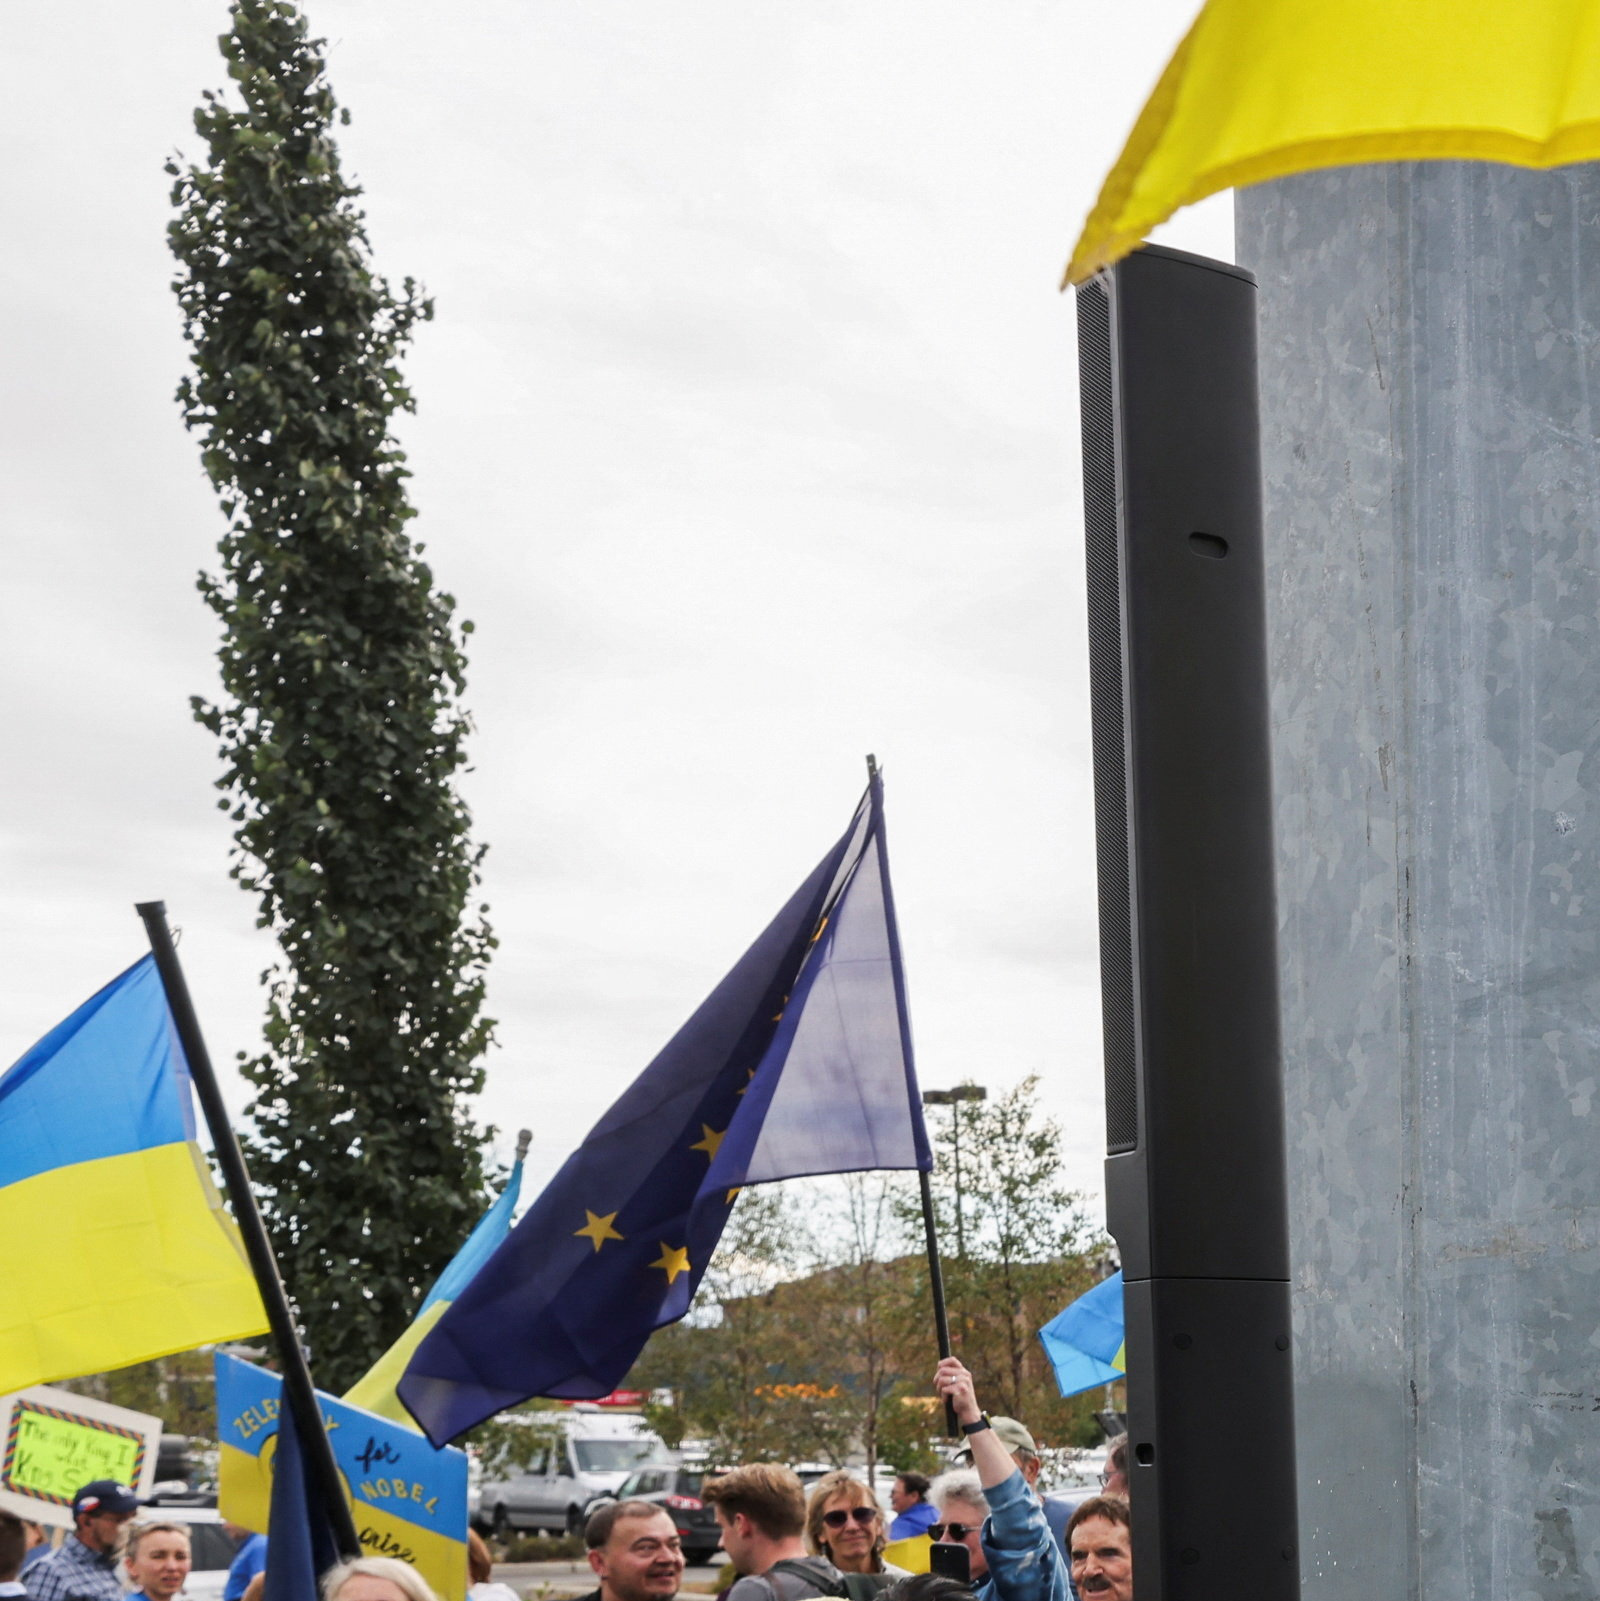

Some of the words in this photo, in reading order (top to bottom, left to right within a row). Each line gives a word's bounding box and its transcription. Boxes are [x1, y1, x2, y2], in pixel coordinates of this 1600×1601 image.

[117, 1444, 130, 1466] I
[355, 1436, 400, 1474] for
[360, 1478, 440, 1515] NOBEL
